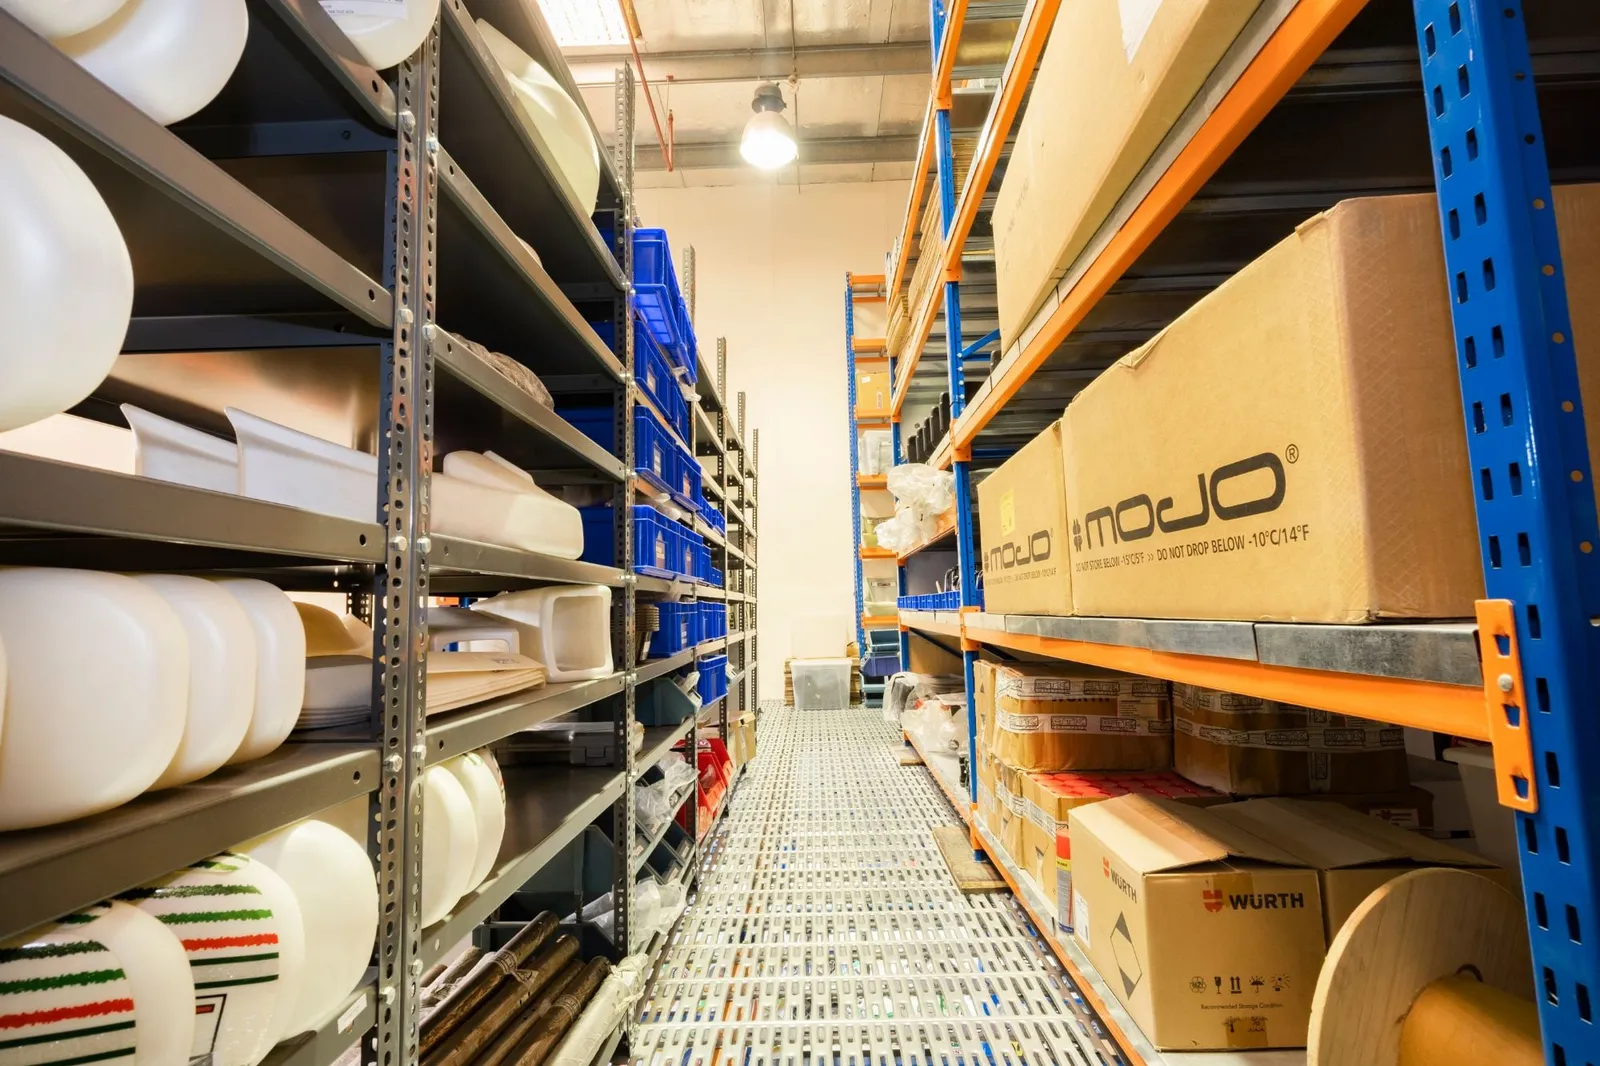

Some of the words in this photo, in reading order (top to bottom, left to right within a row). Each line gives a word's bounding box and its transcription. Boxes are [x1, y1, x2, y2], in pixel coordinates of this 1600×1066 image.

[1104, 556, 1120, 569] BELOW
[1156, 548, 1168, 561] DO
[1169, 545, 1184, 560] NOT
[1186, 541, 1209, 557] DROP
[1211, 535, 1245, 554] BELOW
[1248, 524, 1310, 548] -10°C/14°F
[1110, 868, 1138, 904] WÜRTH
[1228, 892, 1304, 910] WÜRTH
